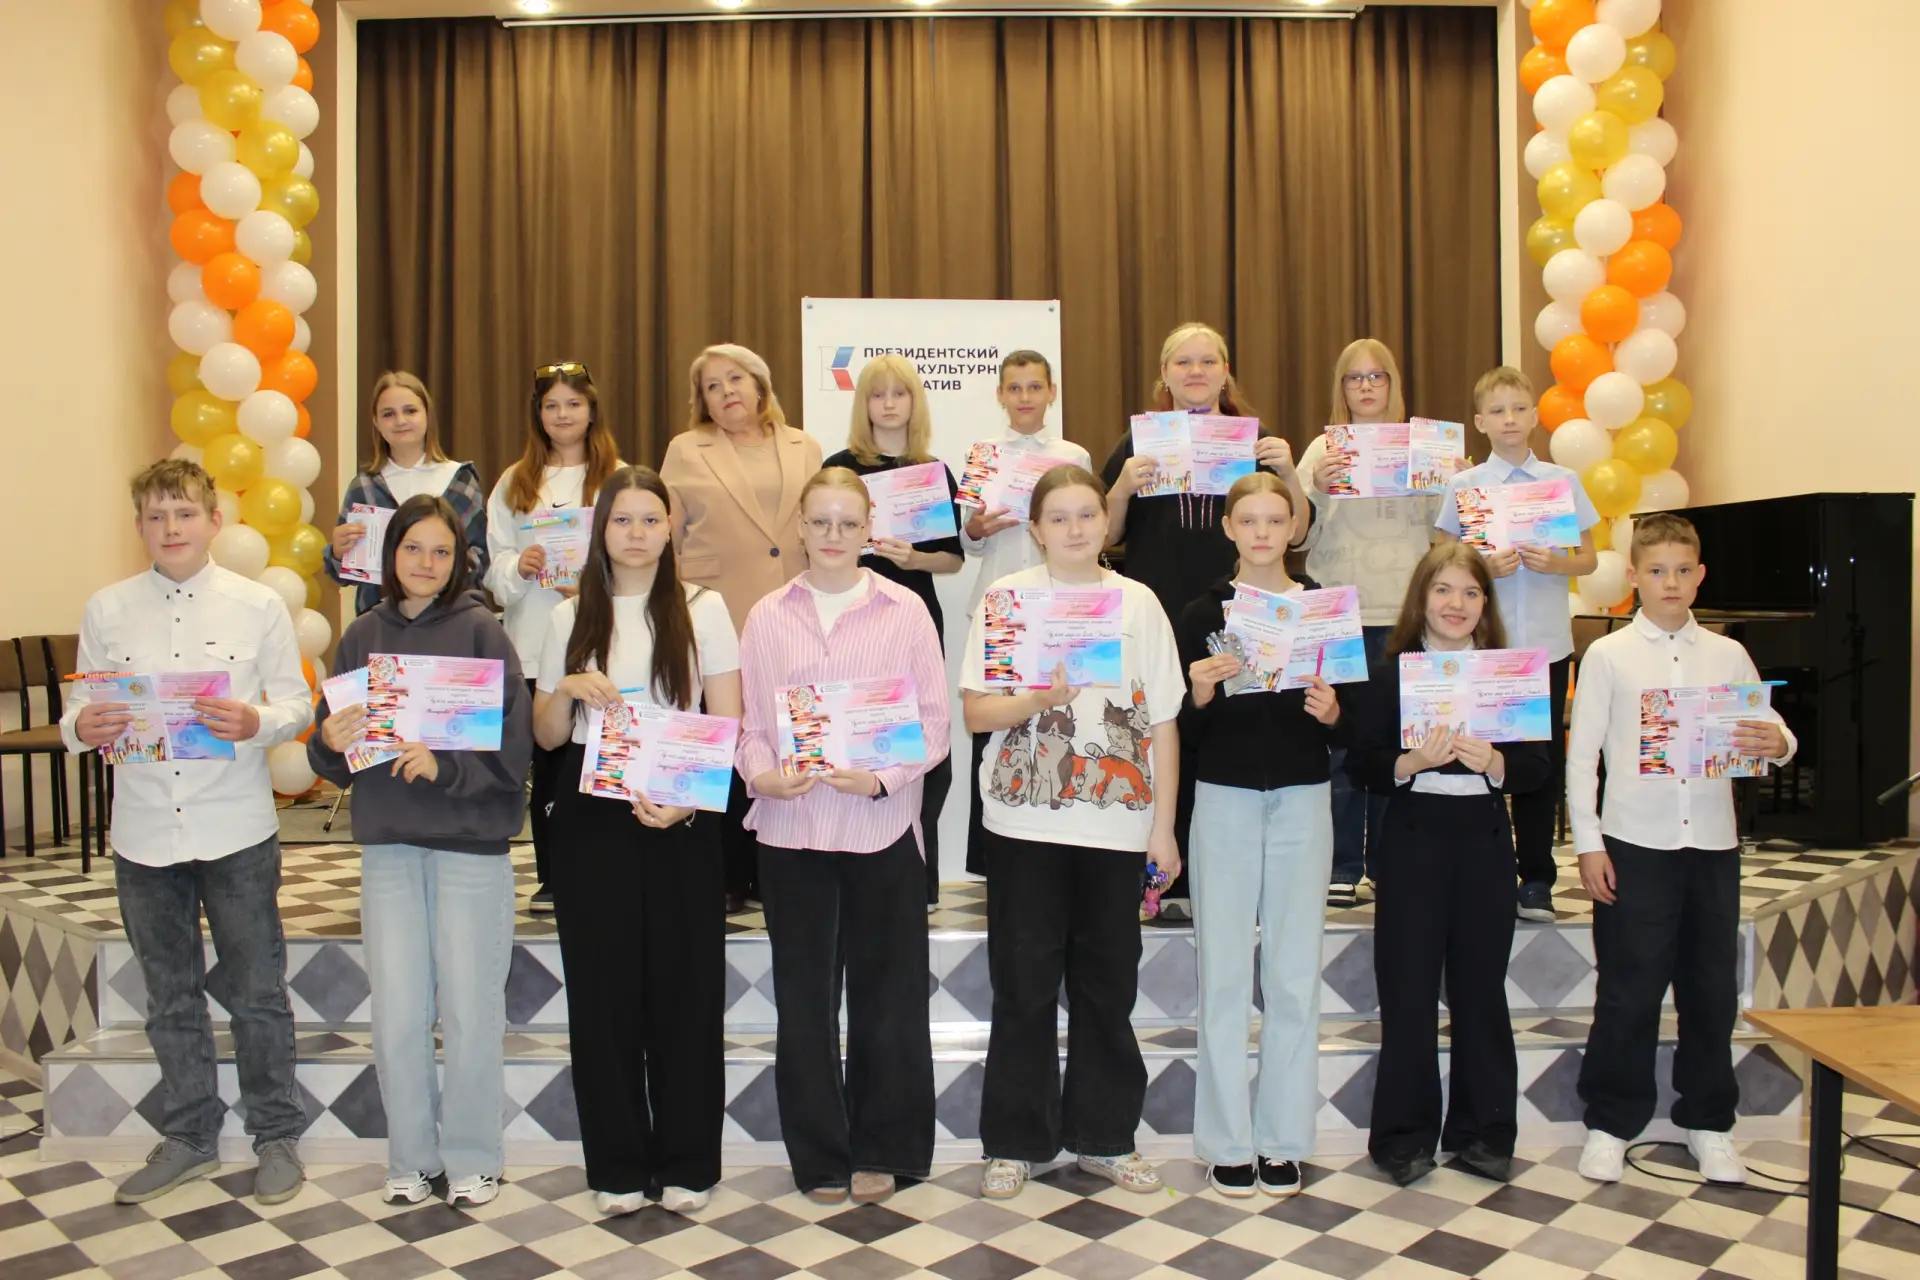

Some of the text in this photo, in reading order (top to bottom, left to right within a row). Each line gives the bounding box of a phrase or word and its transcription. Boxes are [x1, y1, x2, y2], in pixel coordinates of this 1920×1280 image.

[864, 346, 999, 360] ПРЕЗИДЕНТСКИЙ
[917, 364, 1001, 375] КУЛЬТУРН
[923, 380, 962, 390] АТИВ
